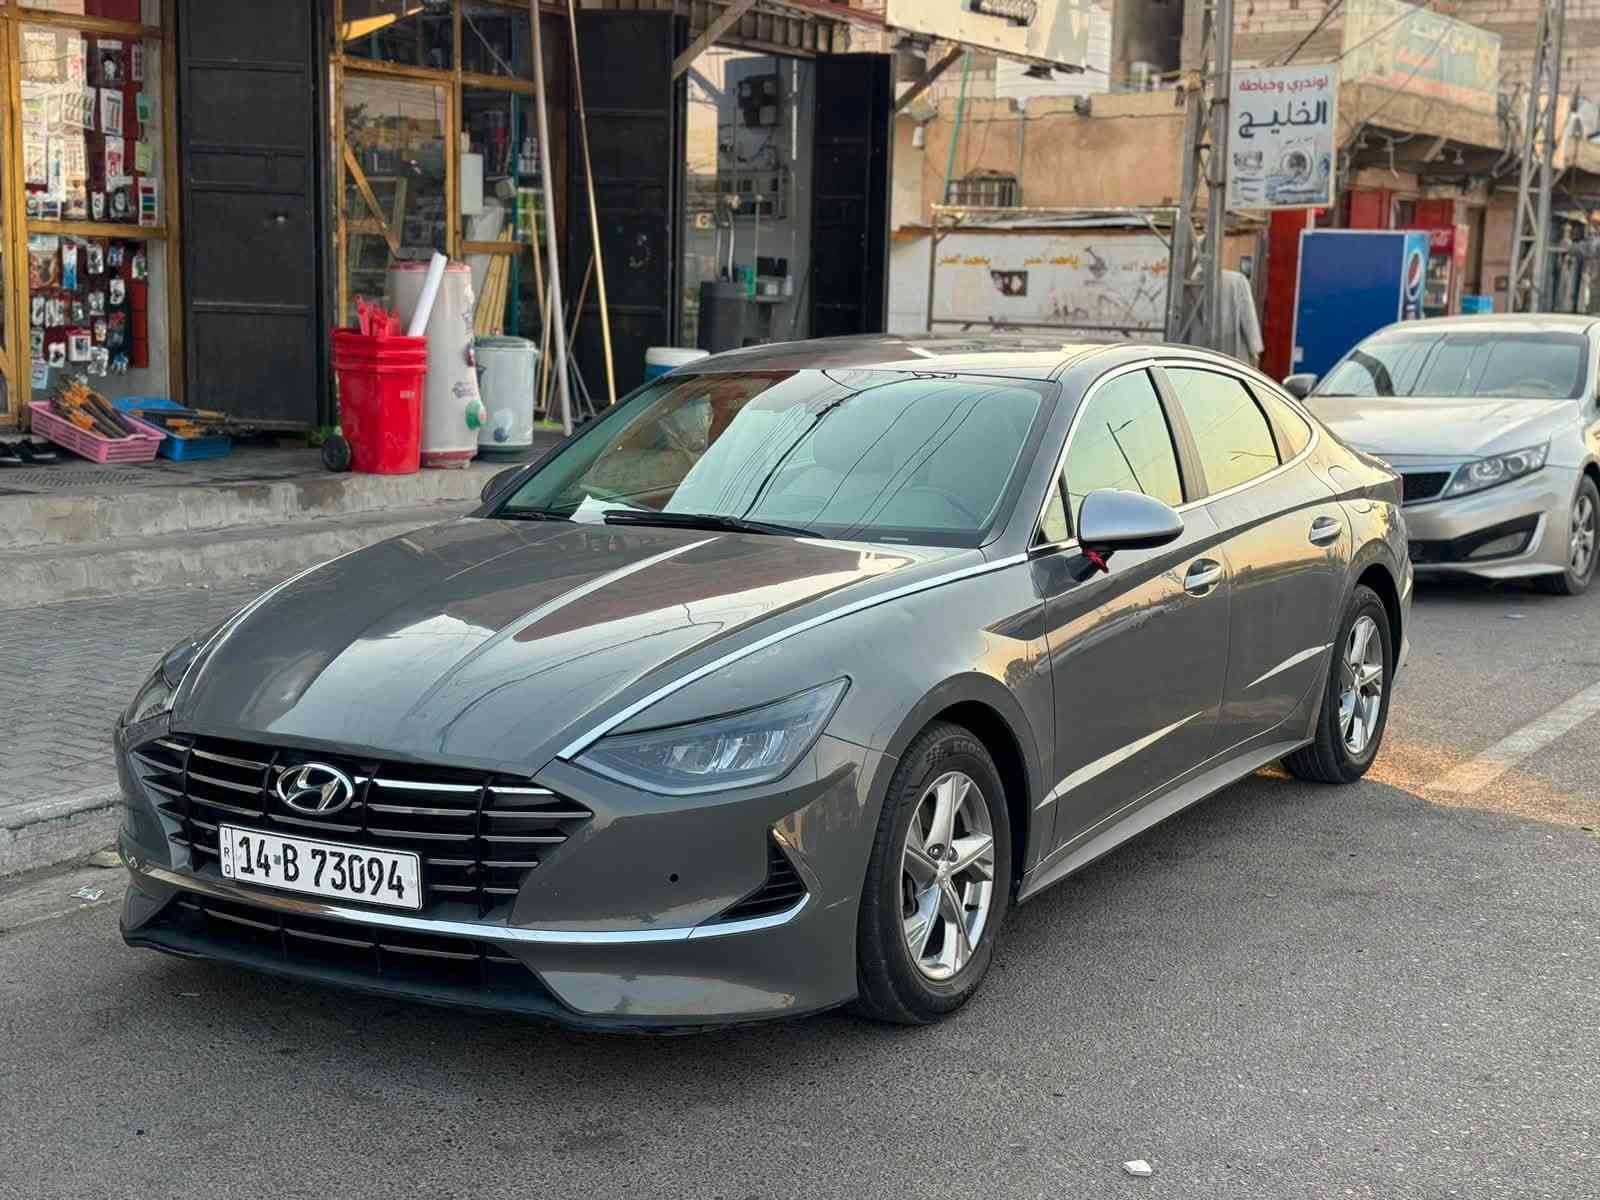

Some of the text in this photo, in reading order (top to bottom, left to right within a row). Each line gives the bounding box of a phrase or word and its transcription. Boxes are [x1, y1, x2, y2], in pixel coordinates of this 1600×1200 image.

[1286, 76, 1328, 94] لوندري
[1238, 100, 1327, 139] الخليج
[238, 835, 405, 900] 14 B 73094
